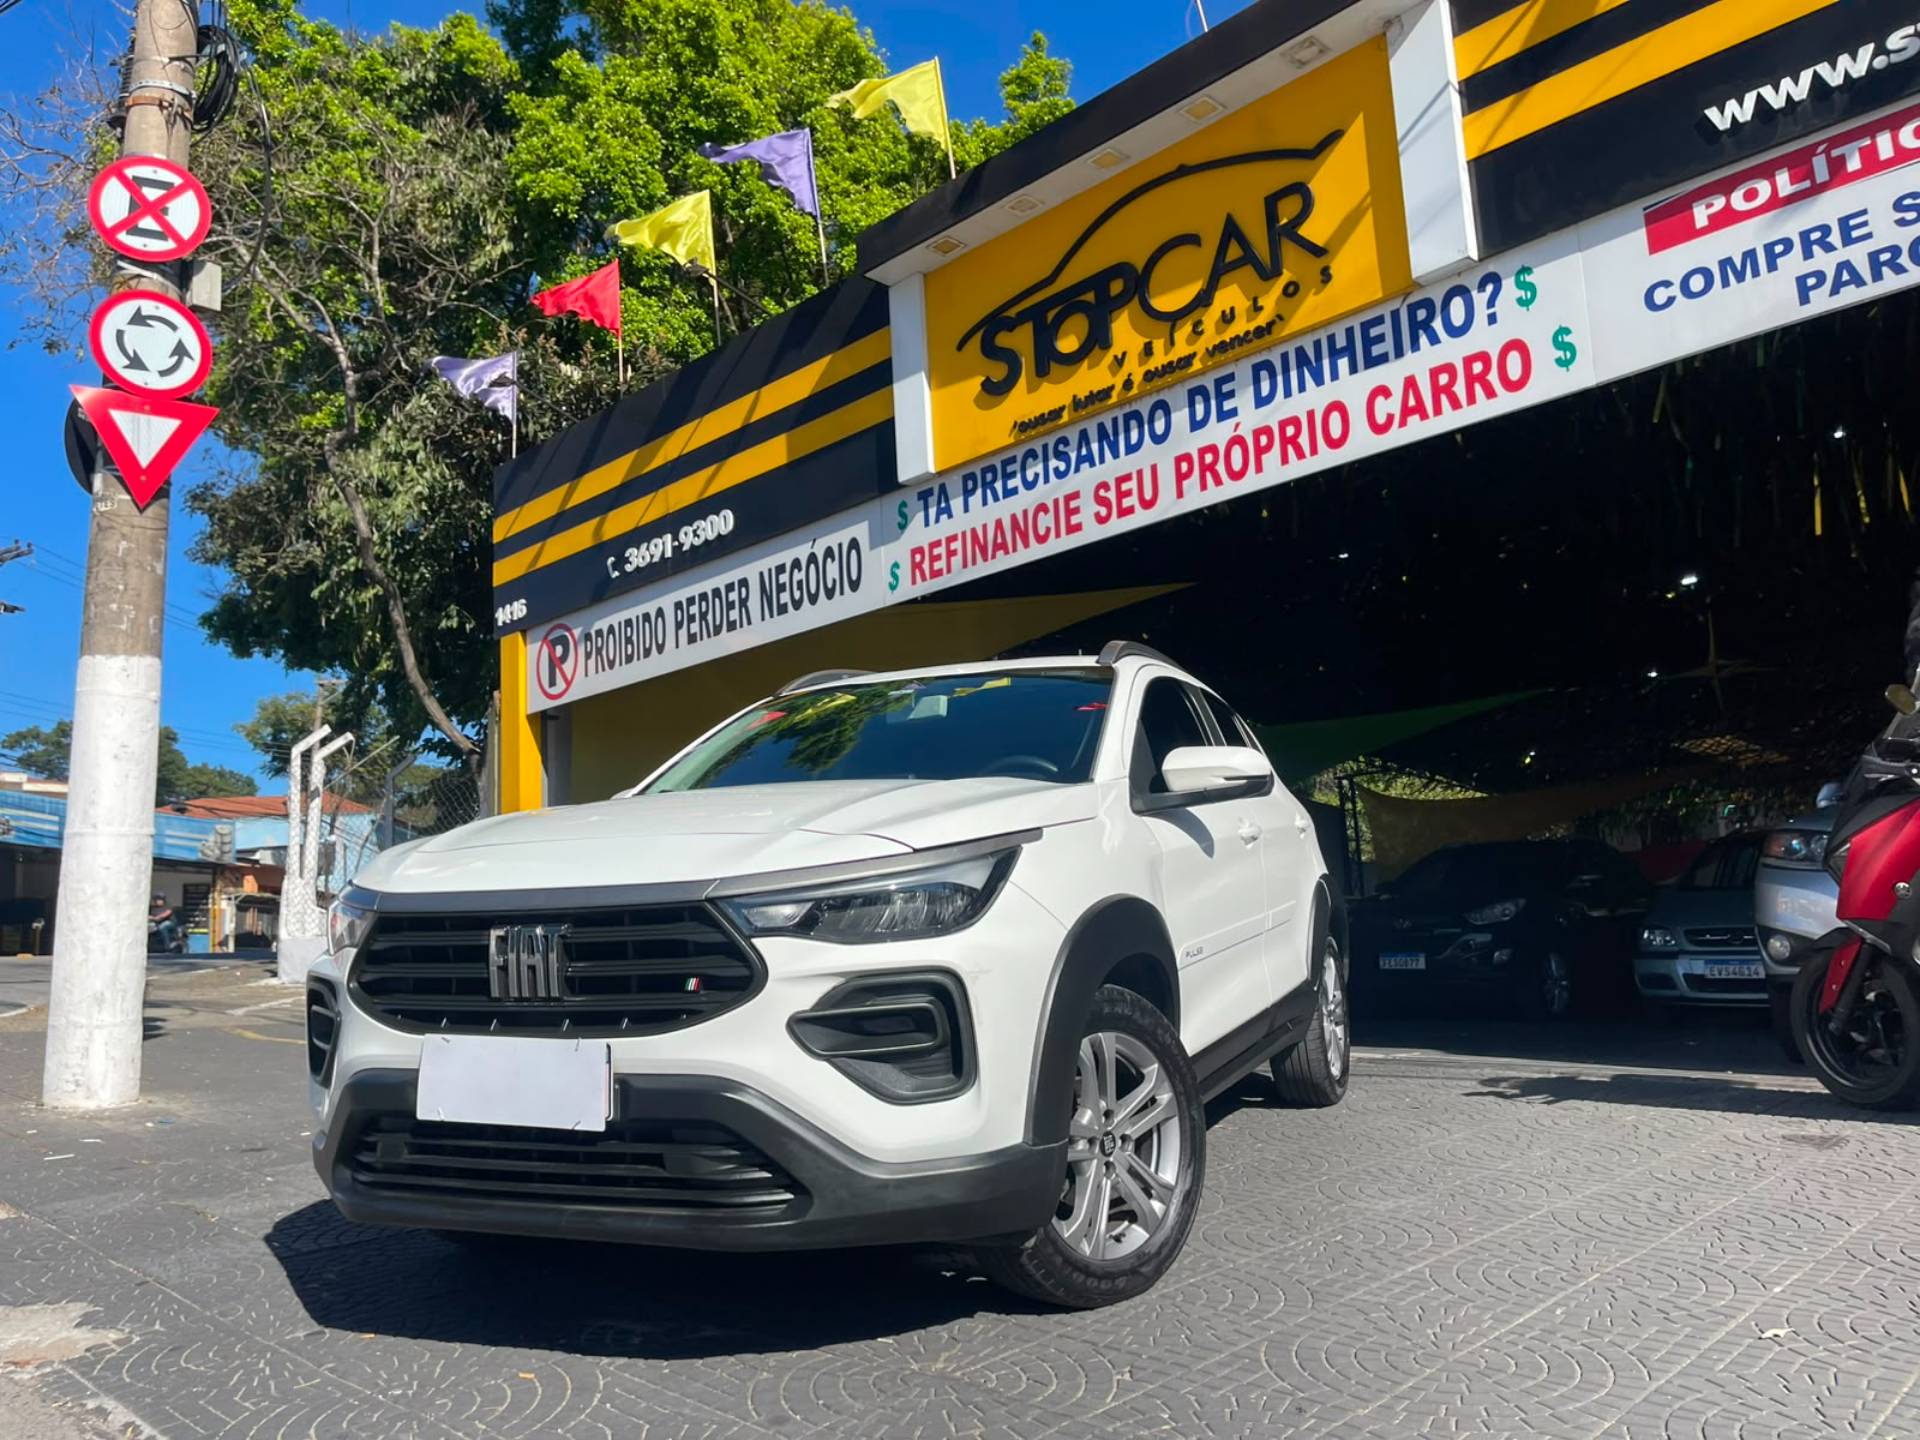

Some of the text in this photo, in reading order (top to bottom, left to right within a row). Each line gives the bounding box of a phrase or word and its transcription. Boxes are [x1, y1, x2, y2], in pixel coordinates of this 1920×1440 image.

[1704, 22, 1920, 131] www.s
[1644, 208, 1873, 313] COMPRE
[918, 483, 953, 528] TA
[962, 399, 1172, 513] PRECISANDO
[1187, 371, 1239, 433] DE
[1251, 271, 1502, 410] DINHEIRO?
[1514, 264, 1537, 311] $
[1143, 351, 1197, 383] ousar
[910, 490, 1082, 586] REFINANCIE
[1093, 463, 1159, 526] SEU
[1174, 400, 1350, 501] PRÓPRIO
[1366, 338, 1532, 436] CARRO
[1552, 325, 1577, 371] $
[624, 509, 734, 573] 3691-9300
[584, 535, 863, 677] PROIBIDO PERDER NEGÓCIO
[490, 924, 571, 998] FIAT
